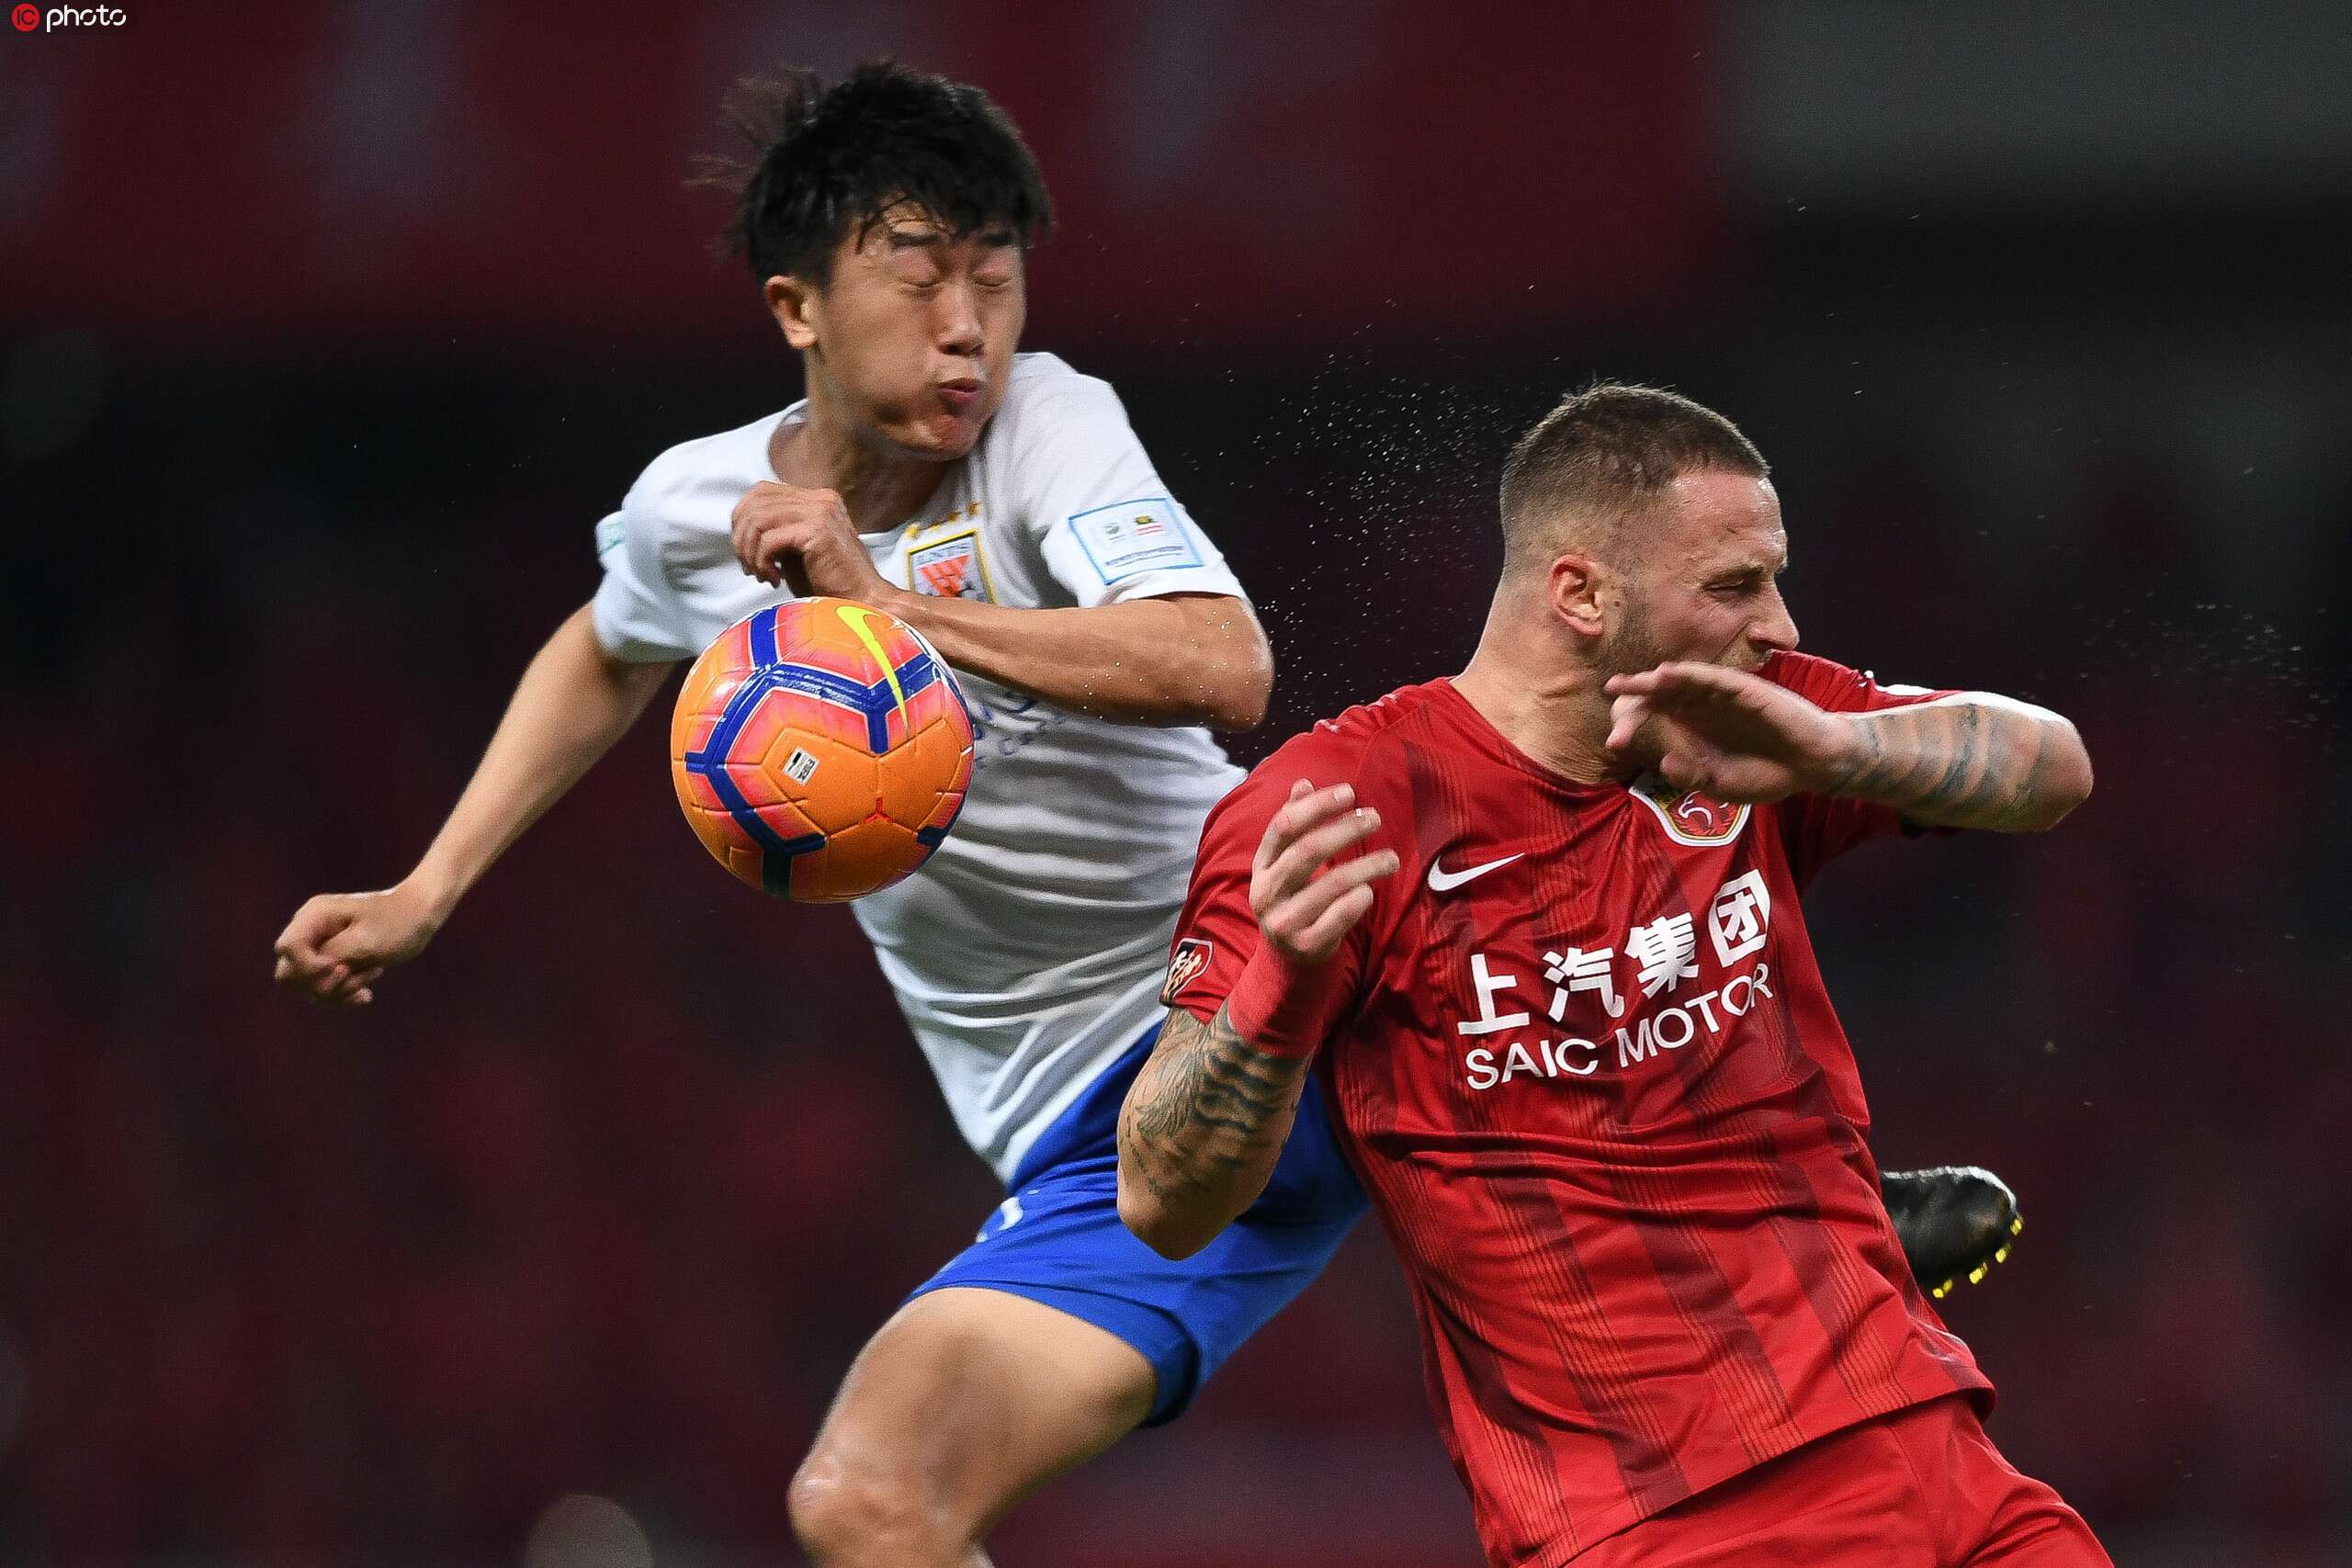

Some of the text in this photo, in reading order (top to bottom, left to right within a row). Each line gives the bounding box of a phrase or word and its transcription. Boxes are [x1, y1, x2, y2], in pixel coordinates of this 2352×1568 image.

[1457, 868, 1770, 1034] 上汽集团
[1465, 963, 1773, 1089] SAIC MOTOR
